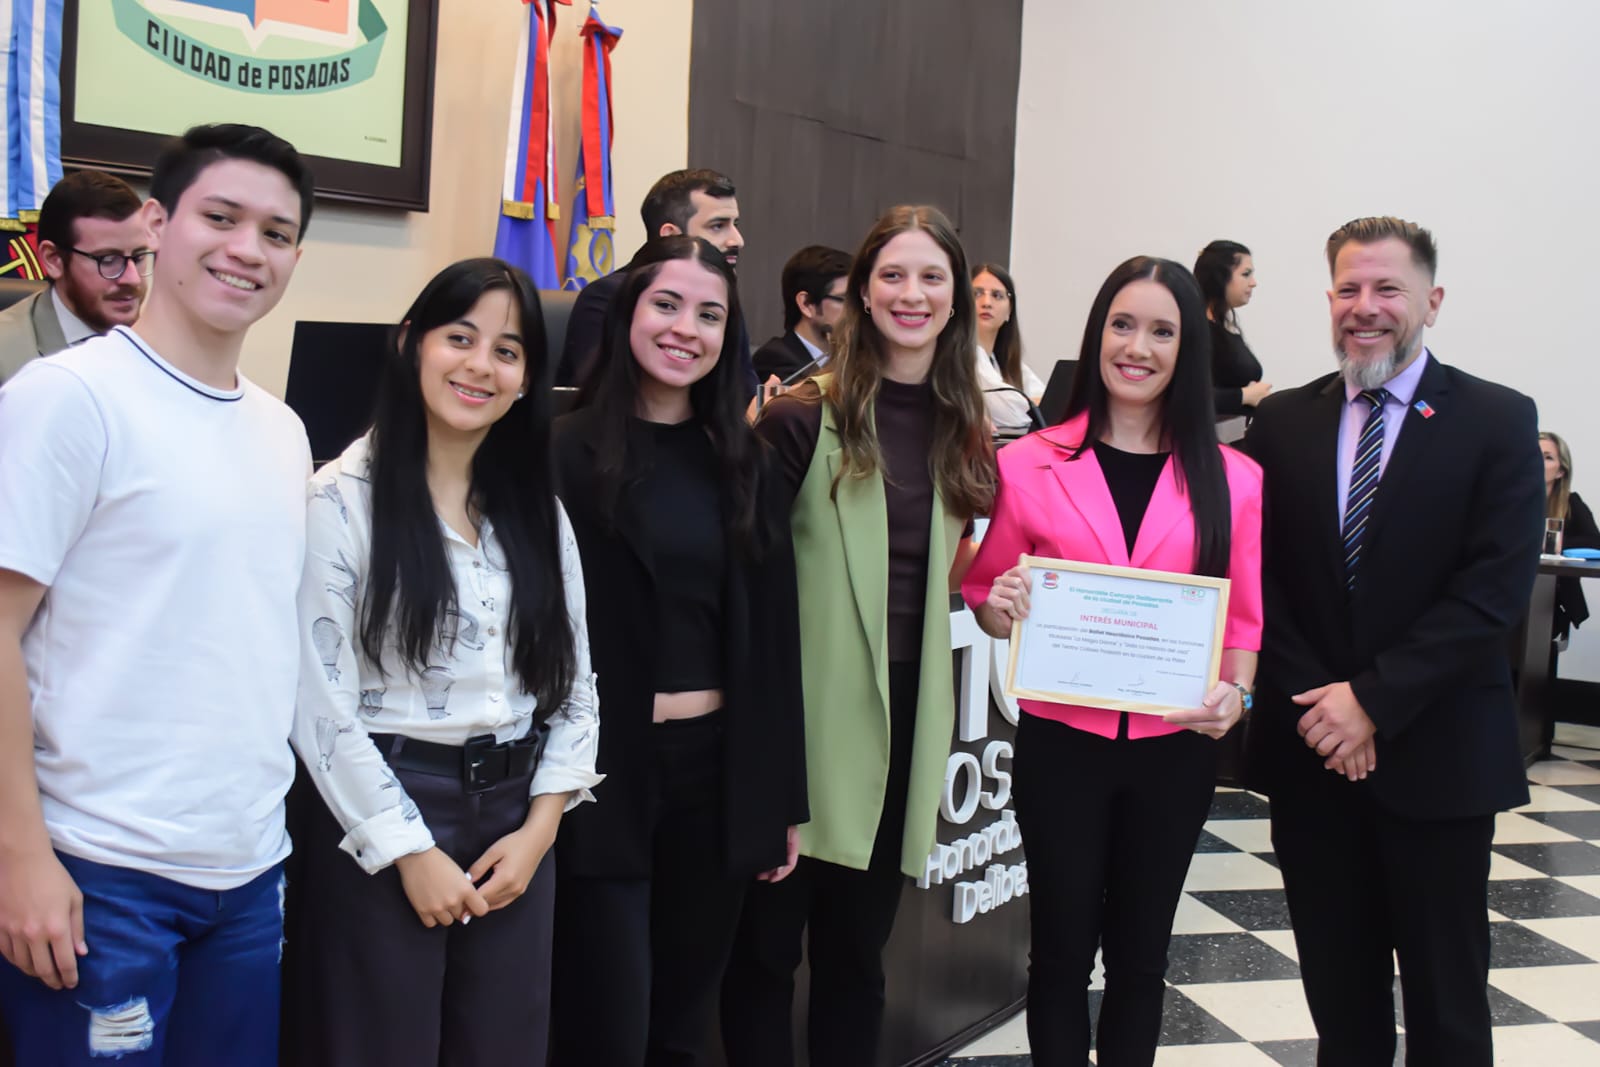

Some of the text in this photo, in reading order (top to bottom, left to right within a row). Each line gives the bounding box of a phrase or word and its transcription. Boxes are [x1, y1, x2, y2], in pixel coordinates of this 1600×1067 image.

[147, 19, 351, 90] CIUDAD de POSADAS
[1080, 614, 1159, 631] INTERÉS MUNICIPAL
[916, 809, 1023, 889] Honorab
[953, 860, 1030, 923] Delibe
